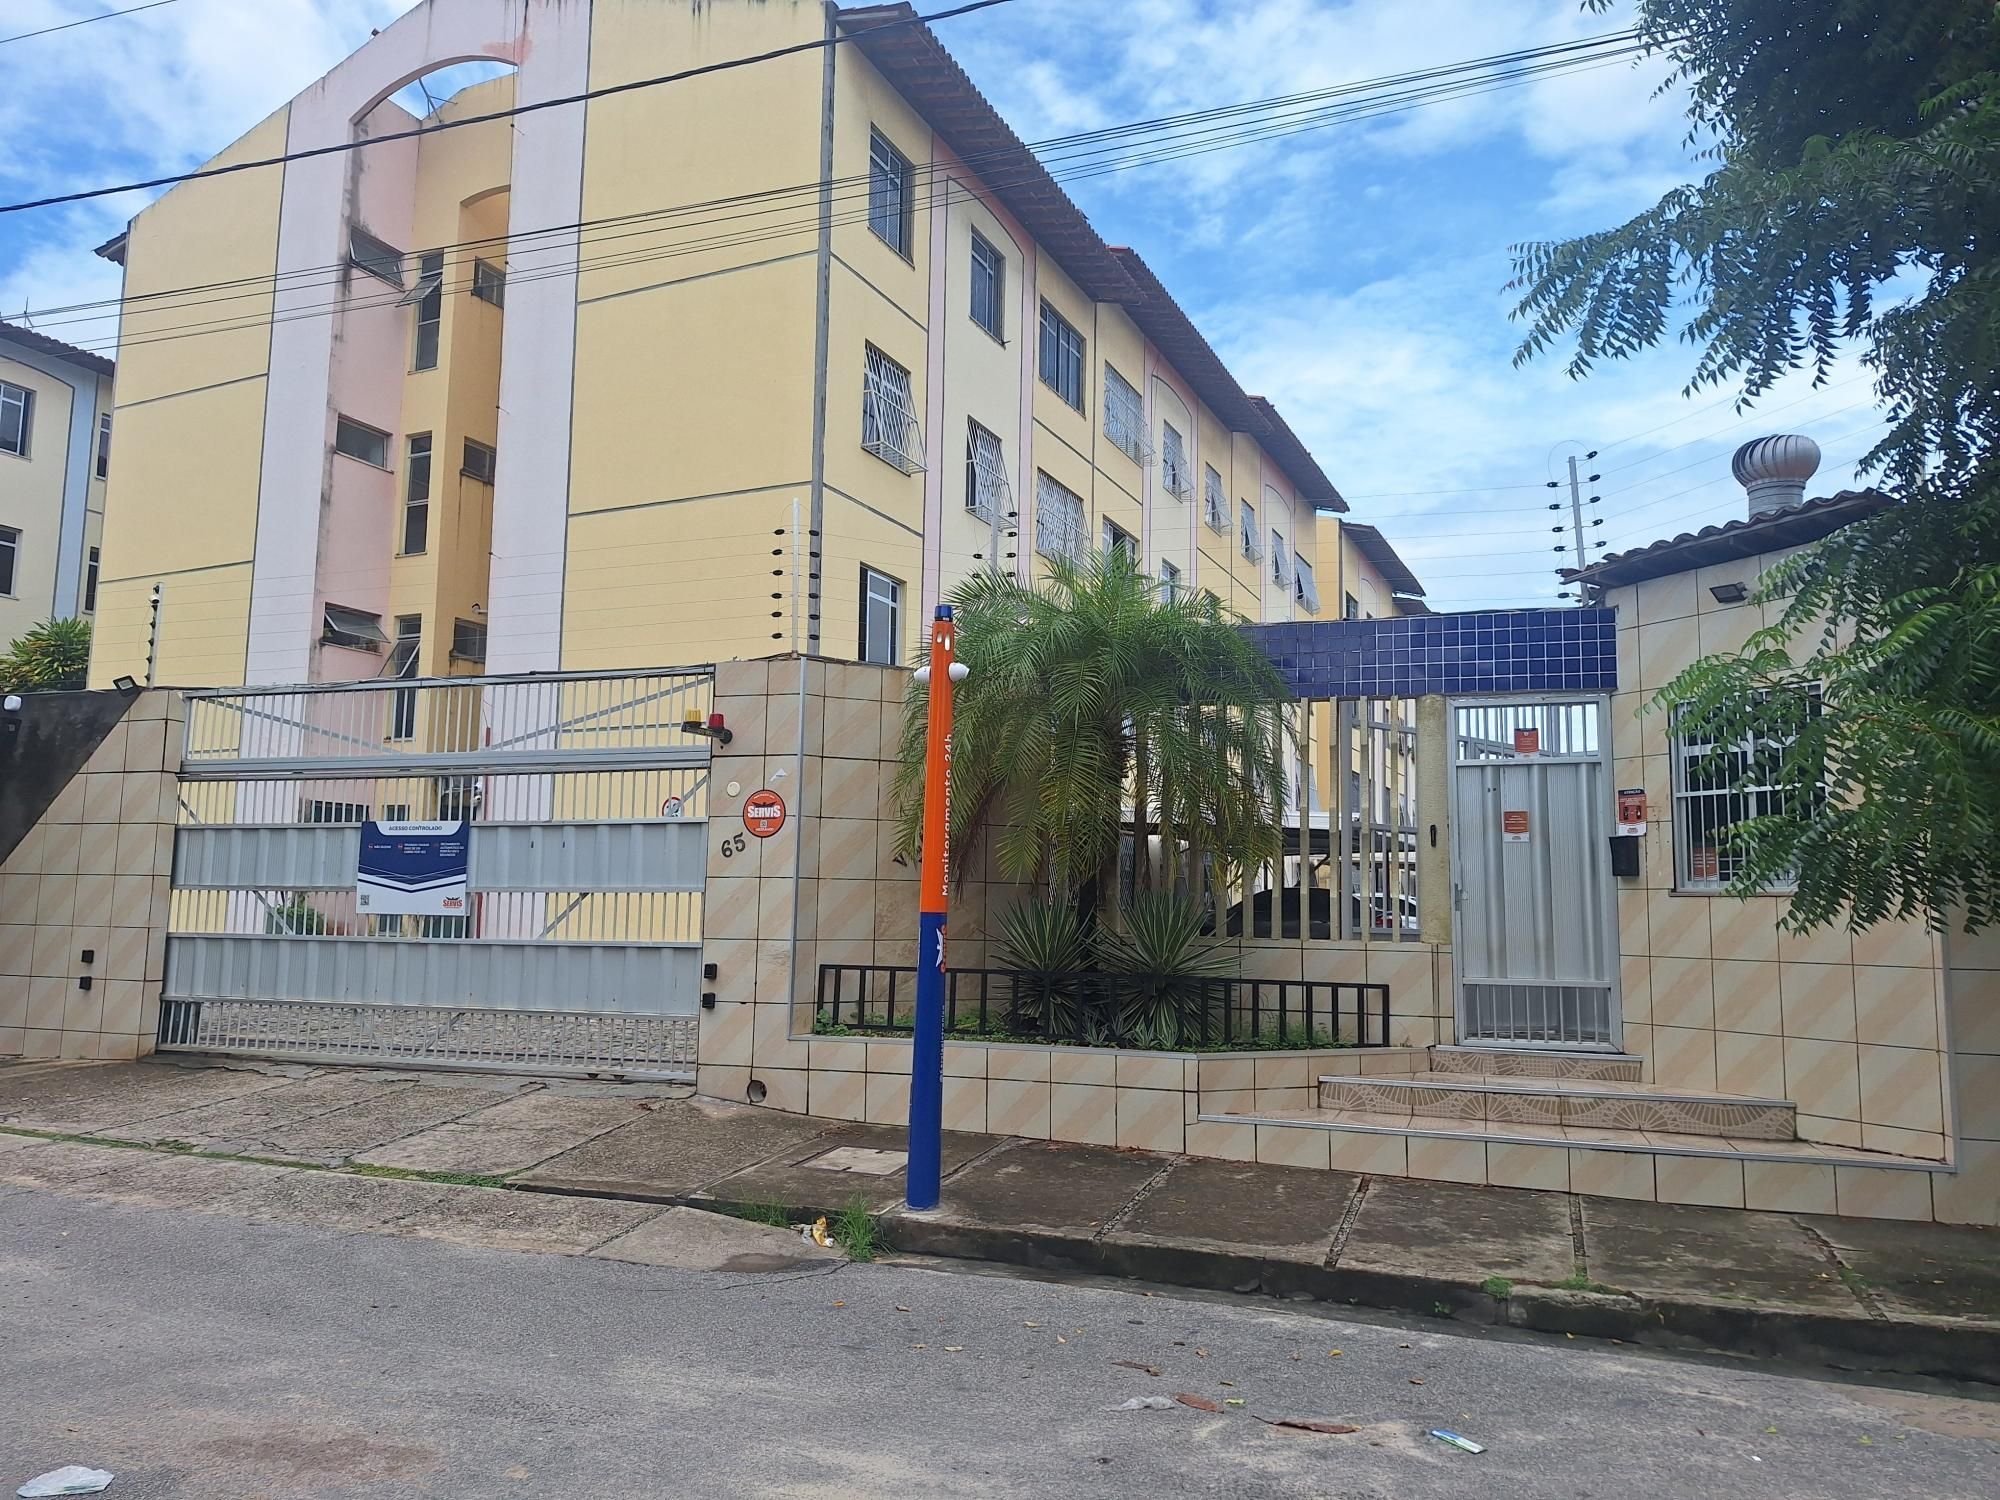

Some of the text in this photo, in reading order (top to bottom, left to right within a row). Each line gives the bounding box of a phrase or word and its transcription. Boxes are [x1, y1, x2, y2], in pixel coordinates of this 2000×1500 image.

[747, 805, 781, 818] SERVIS
[941, 733, 952, 897] Monitoramento 24h
[721, 832, 746, 858] 65
[442, 899, 463, 907] SERVIS
